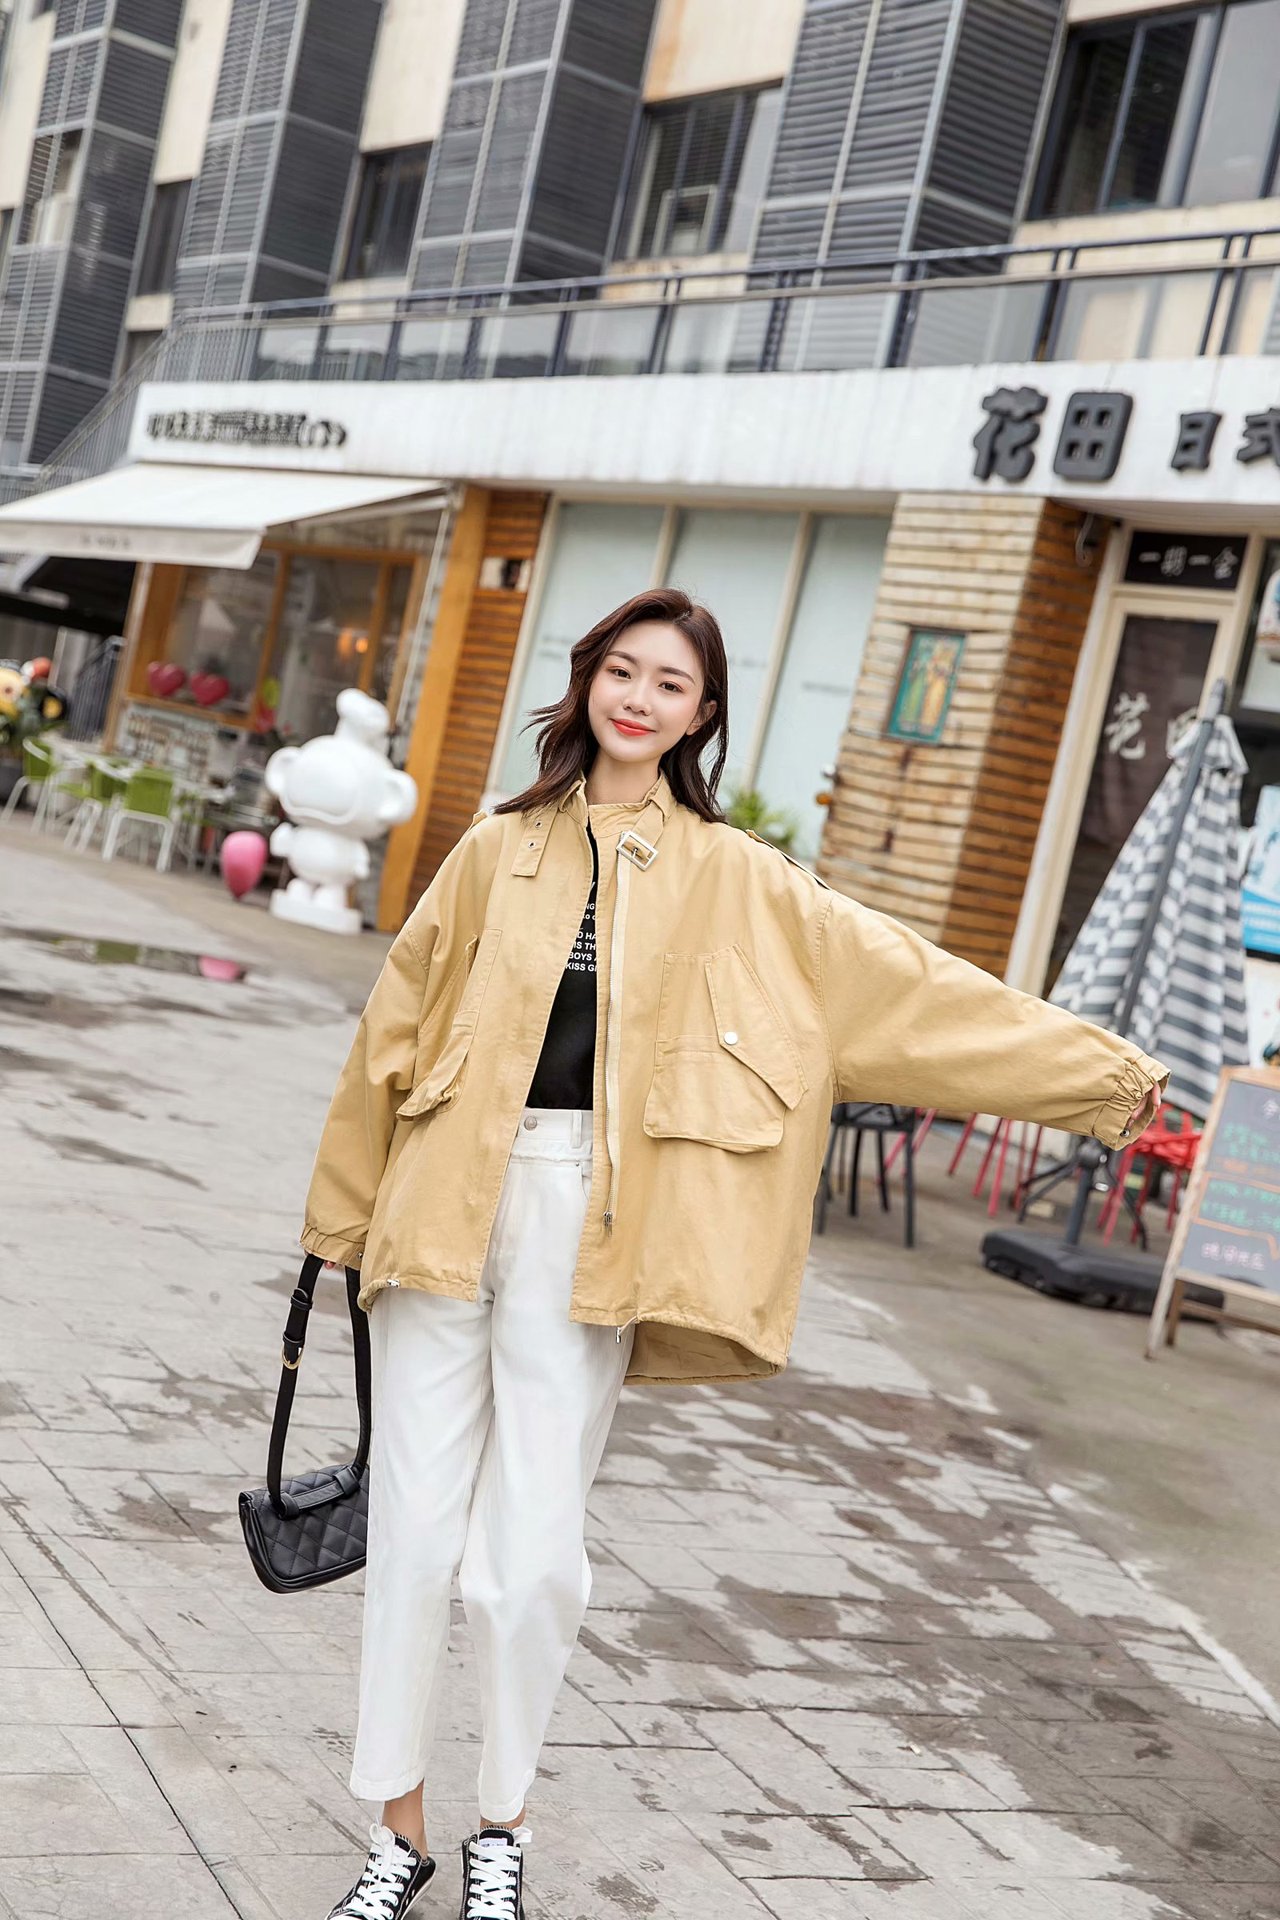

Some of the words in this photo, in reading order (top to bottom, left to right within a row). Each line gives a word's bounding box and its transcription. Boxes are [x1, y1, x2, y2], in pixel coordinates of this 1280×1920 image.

[973, 387, 1133, 482] 花田
[569, 951, 593, 961] BOYS
[565, 962, 586, 971] KISS
